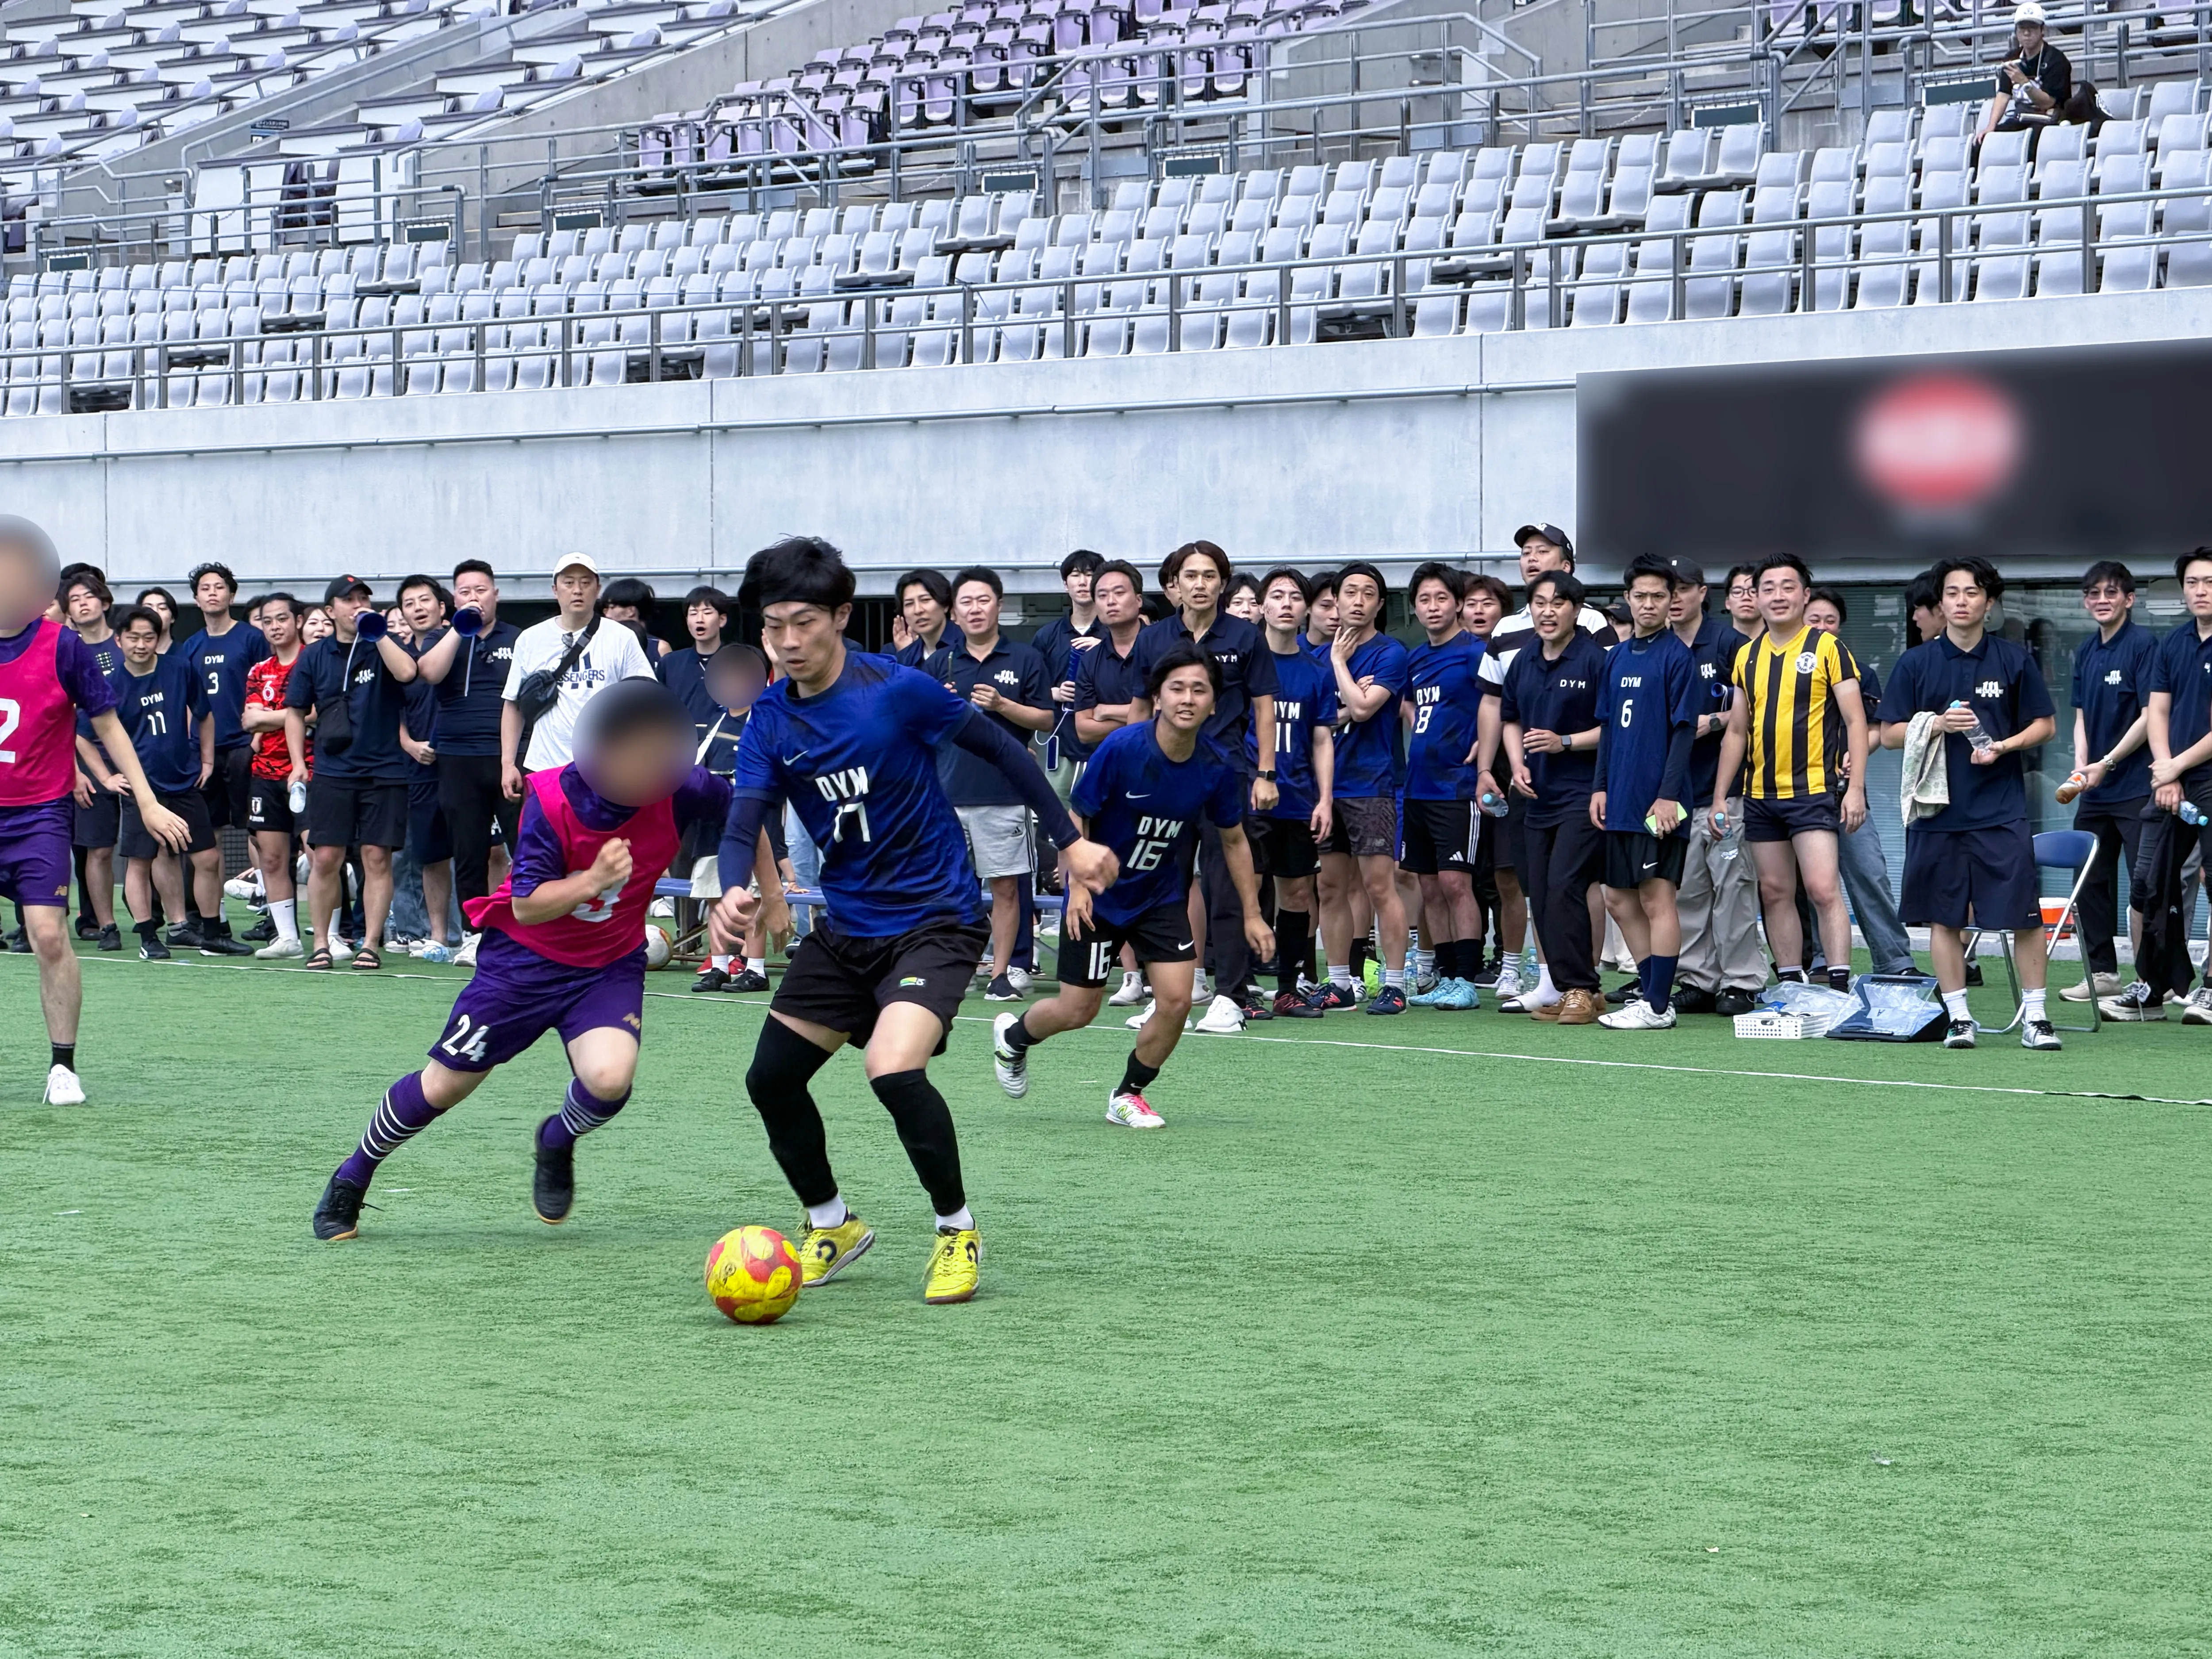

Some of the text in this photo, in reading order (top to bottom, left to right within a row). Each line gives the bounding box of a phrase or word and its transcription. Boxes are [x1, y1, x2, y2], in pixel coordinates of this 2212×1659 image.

[205, 655, 224, 664] DYM
[207, 672, 219, 694] 3
[262, 680, 274, 701] 6
[1559, 679, 1586, 689] DYM
[1621, 676, 1642, 687] DYM
[141, 692, 164, 706] DYM
[1417, 686, 1440, 706] DYM
[147, 711, 166, 736] 11
[1415, 706, 1433, 733] 8
[1621, 699, 1633, 728] 6
[814, 766, 869, 802] DYM
[833, 801, 871, 843] 17
[1137, 816, 1184, 838] DYM
[1126, 839, 1170, 871] 16
[1088, 940, 1113, 980] 16
[442, 1014, 489, 1062] 24
